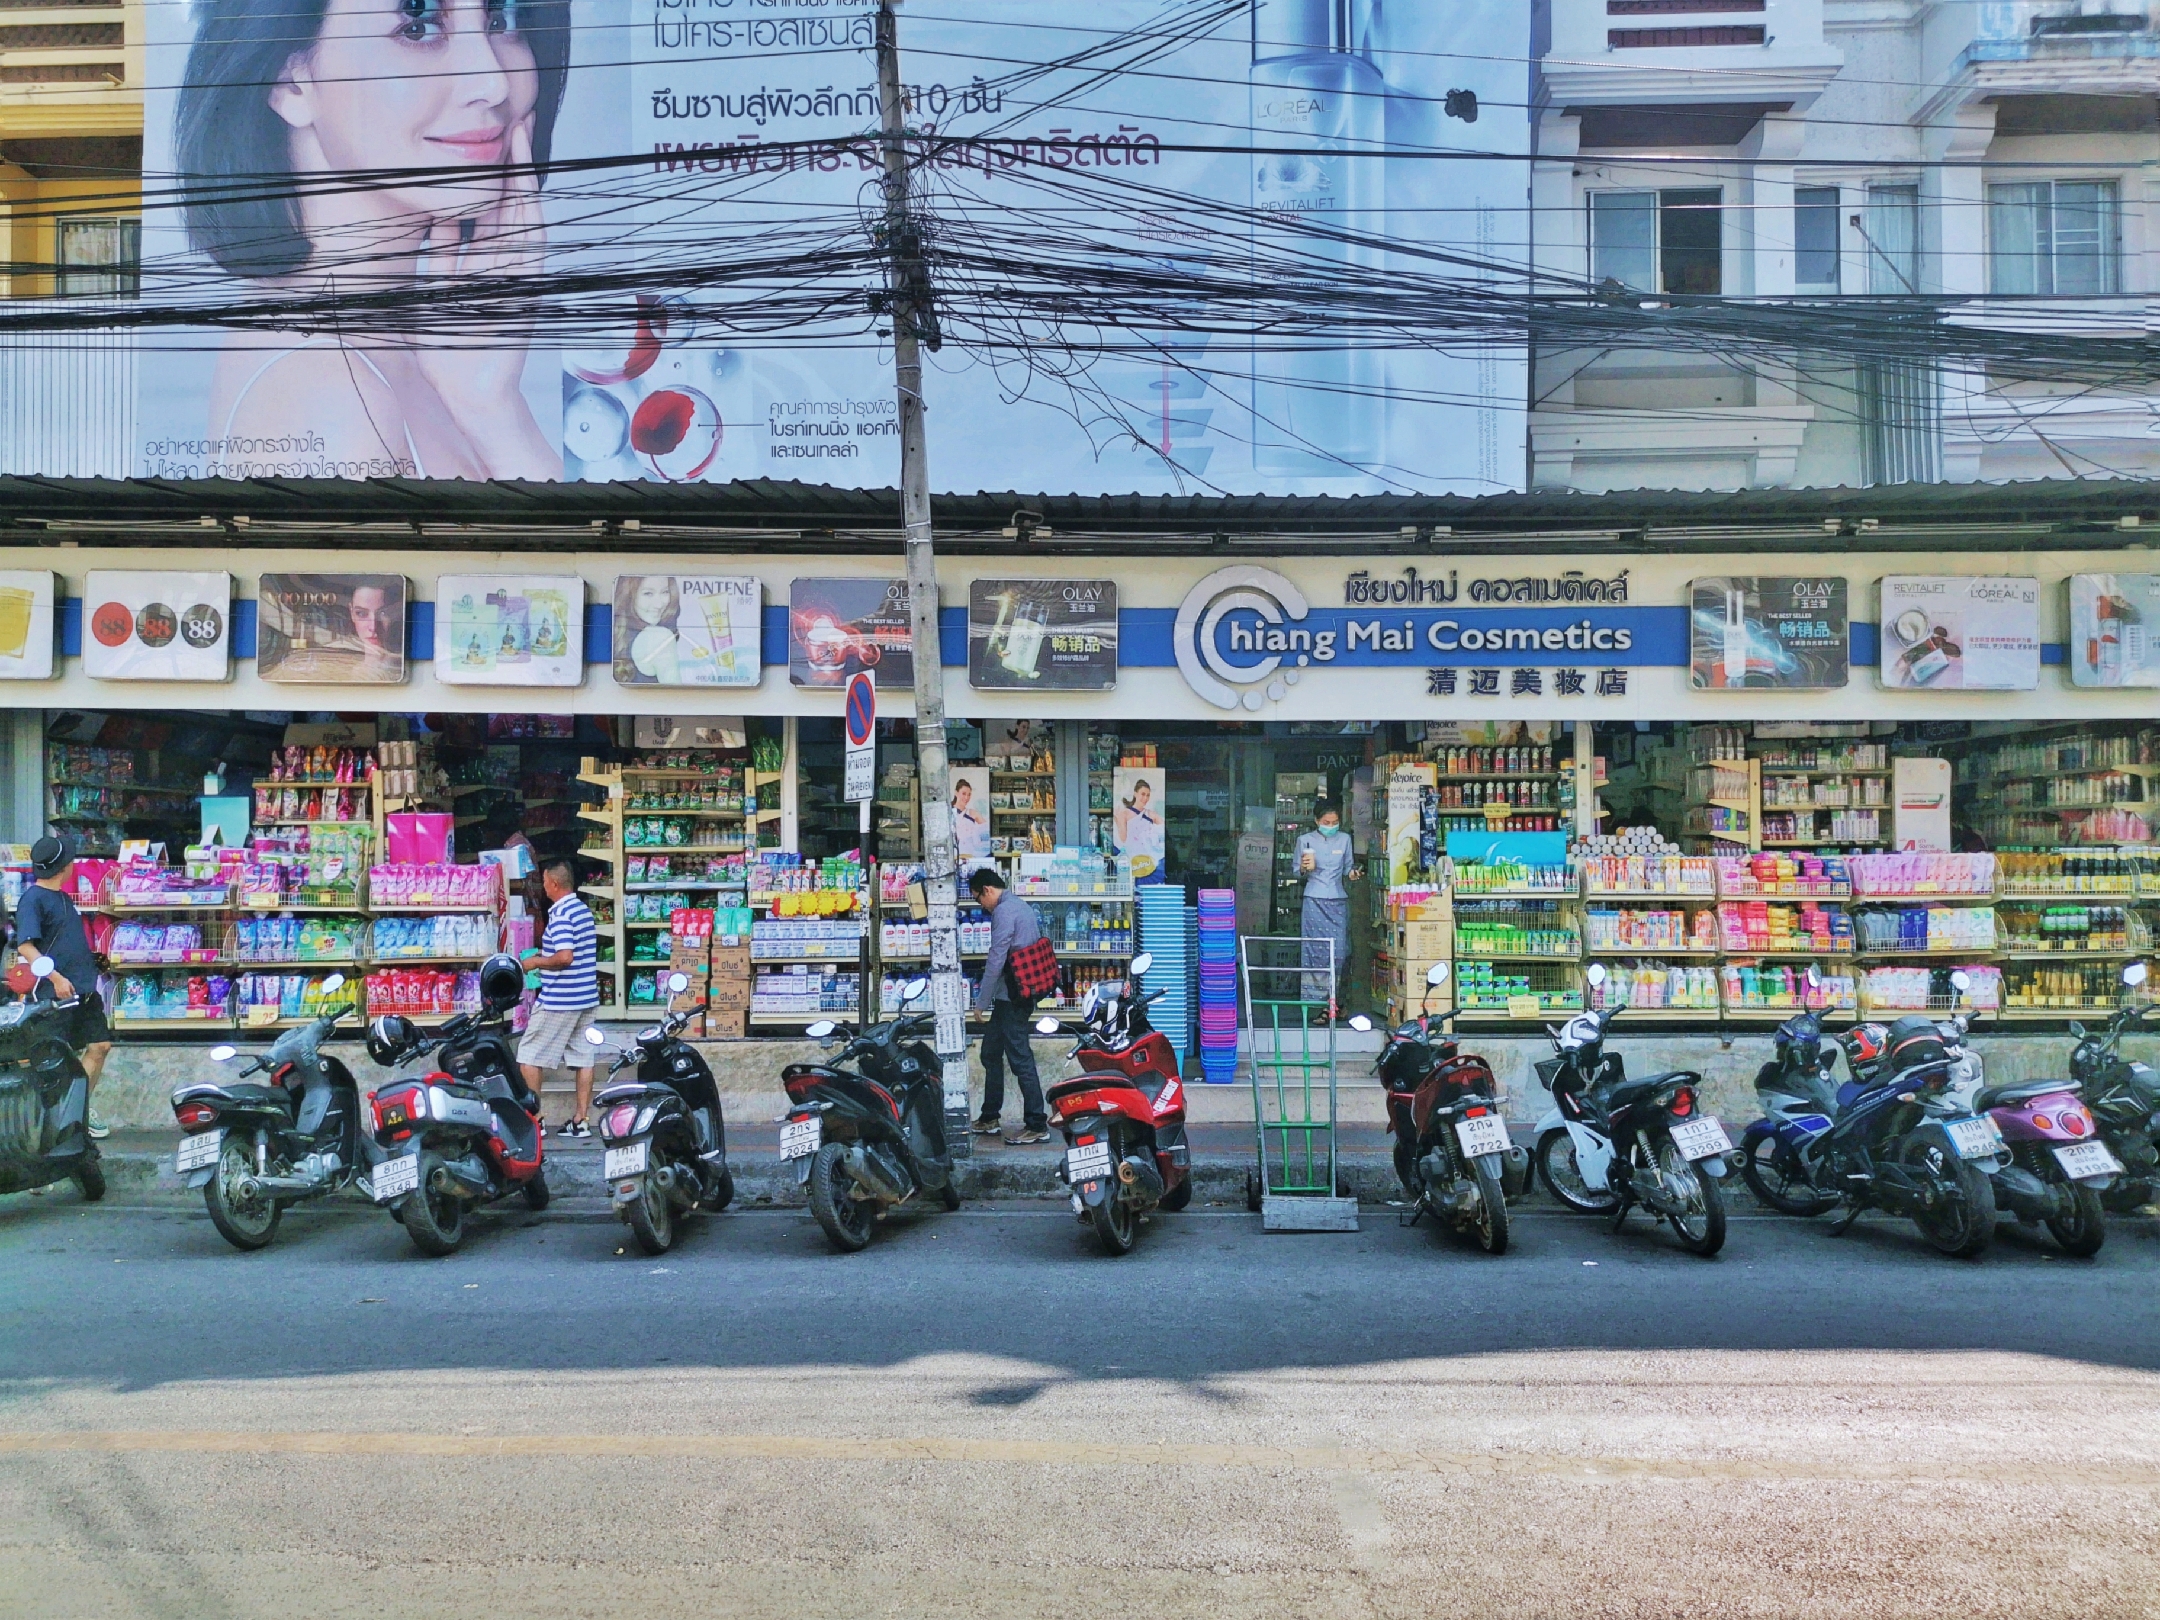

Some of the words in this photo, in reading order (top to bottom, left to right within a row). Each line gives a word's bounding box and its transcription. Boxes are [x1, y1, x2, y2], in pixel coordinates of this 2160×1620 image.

[911, 84, 947, 115] 10
[963, 76, 1001, 114] ชั้น
[1261, 197, 1336, 212] REVITALIFT
[770, 398, 896, 419] คุณค่าการบำรุงผิว
[683, 580, 754, 596] PANTENE
[887, 585, 909, 599] OL
[1062, 586, 1103, 600] OLAY
[1345, 567, 1457, 604] เชียงใหม่
[1468, 568, 1631, 604] คอสเมติคส์
[1793, 582, 1835, 597] OLAY
[1894, 583, 1946, 593] REVITALIFT
[893, 601, 911, 611] 玉兰
[1069, 603, 1096, 613] 玉兰油
[1801, 599, 1828, 609] 玉兰油
[188, 619, 215, 639] 88
[1347, 620, 1414, 651] Mai
[1427, 619, 1632, 651] Cosmetics
[1779, 621, 1830, 638] 畅销品
[1052, 636, 1101, 653] 畅销品
[1427, 668, 1628, 696] 清迈美妆店
[1316, 754, 1362, 770] PANT
[1390, 771, 1422, 784] Rejoice
[262, 1012, 274, 1023] 25
[1068, 1097, 1082, 1108] P5
[787, 1143, 813, 1158] 2024
[1471, 1140, 1503, 1154] 2722
[1690, 1141, 1723, 1157] 3299
[609, 1164, 640, 1178] 6650
[1075, 1166, 1105, 1180] 5050
[2074, 1162, 2107, 1175] 3199
[381, 1180, 411, 1197] 5348
